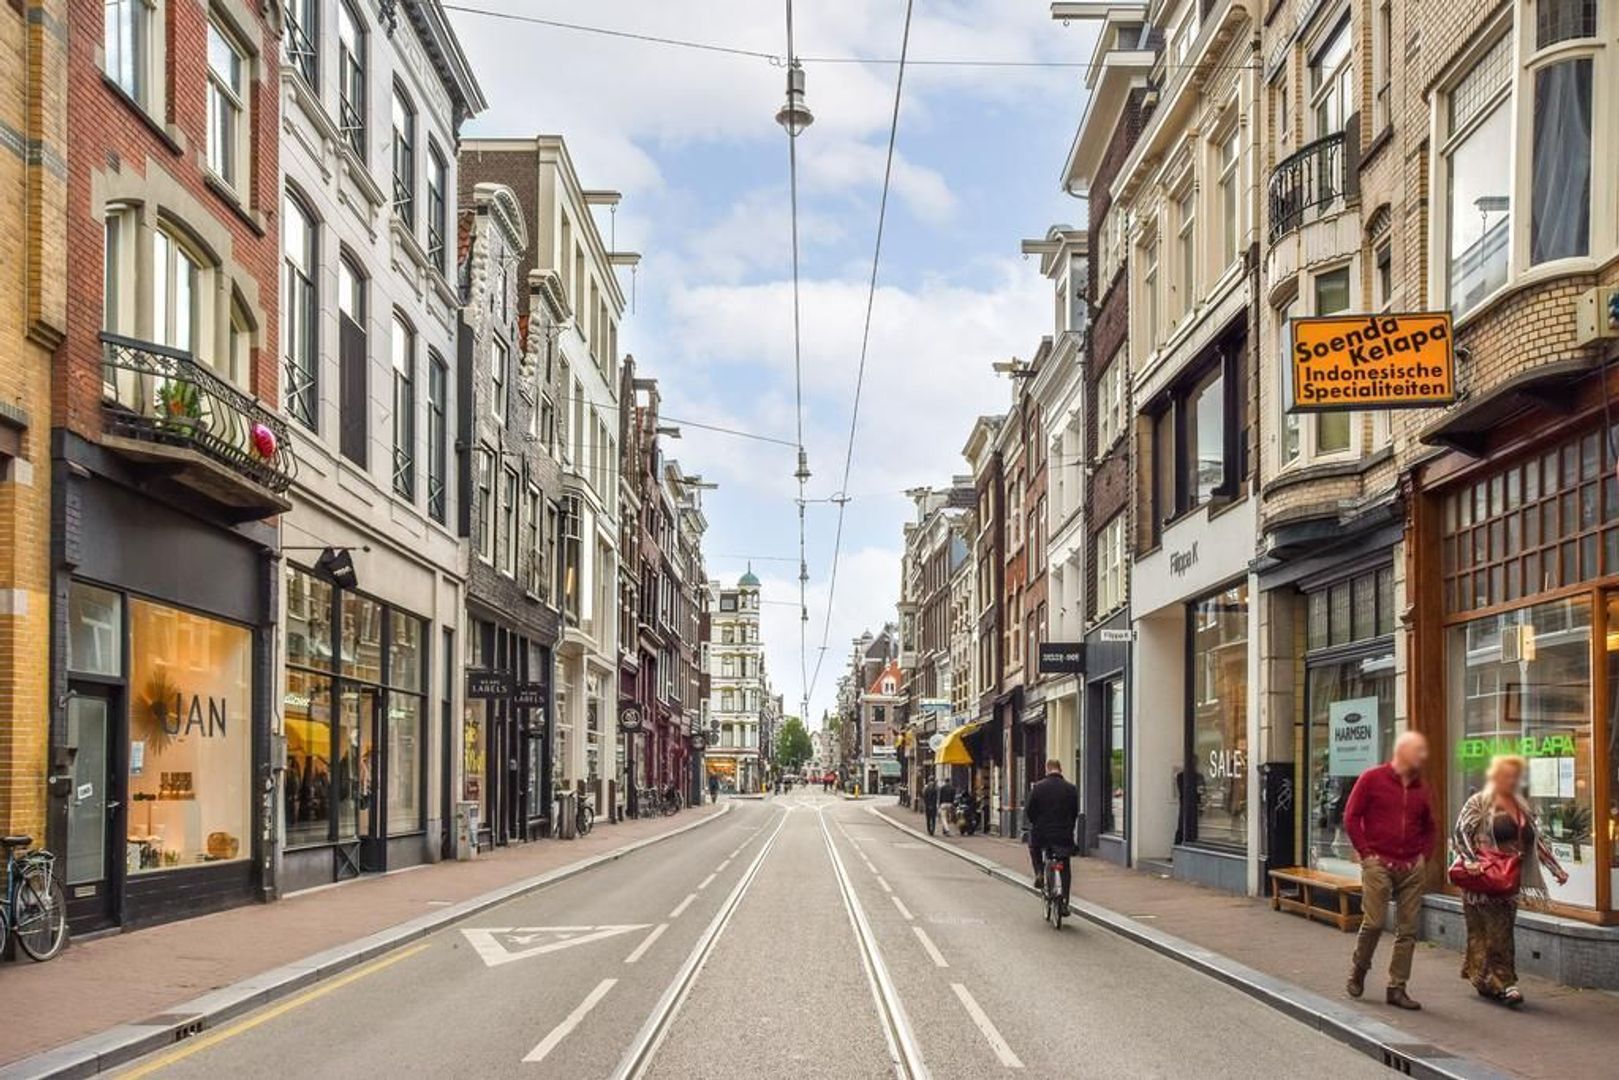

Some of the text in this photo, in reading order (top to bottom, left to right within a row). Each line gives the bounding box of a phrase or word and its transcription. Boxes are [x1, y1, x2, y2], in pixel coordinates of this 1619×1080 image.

[1295, 317, 1399, 363] Soenda
[1348, 323, 1447, 367] Kelapa
[1305, 363, 1443, 381] Indonesische
[1303, 380, 1445, 402] Specialiteiten
[1192, 540, 1199, 565] K
[472, 685, 508, 694] LABELS
[163, 692, 226, 737] JAN
[1334, 724, 1373, 742] HARMSEN
[1209, 749, 1242, 778] SALE
